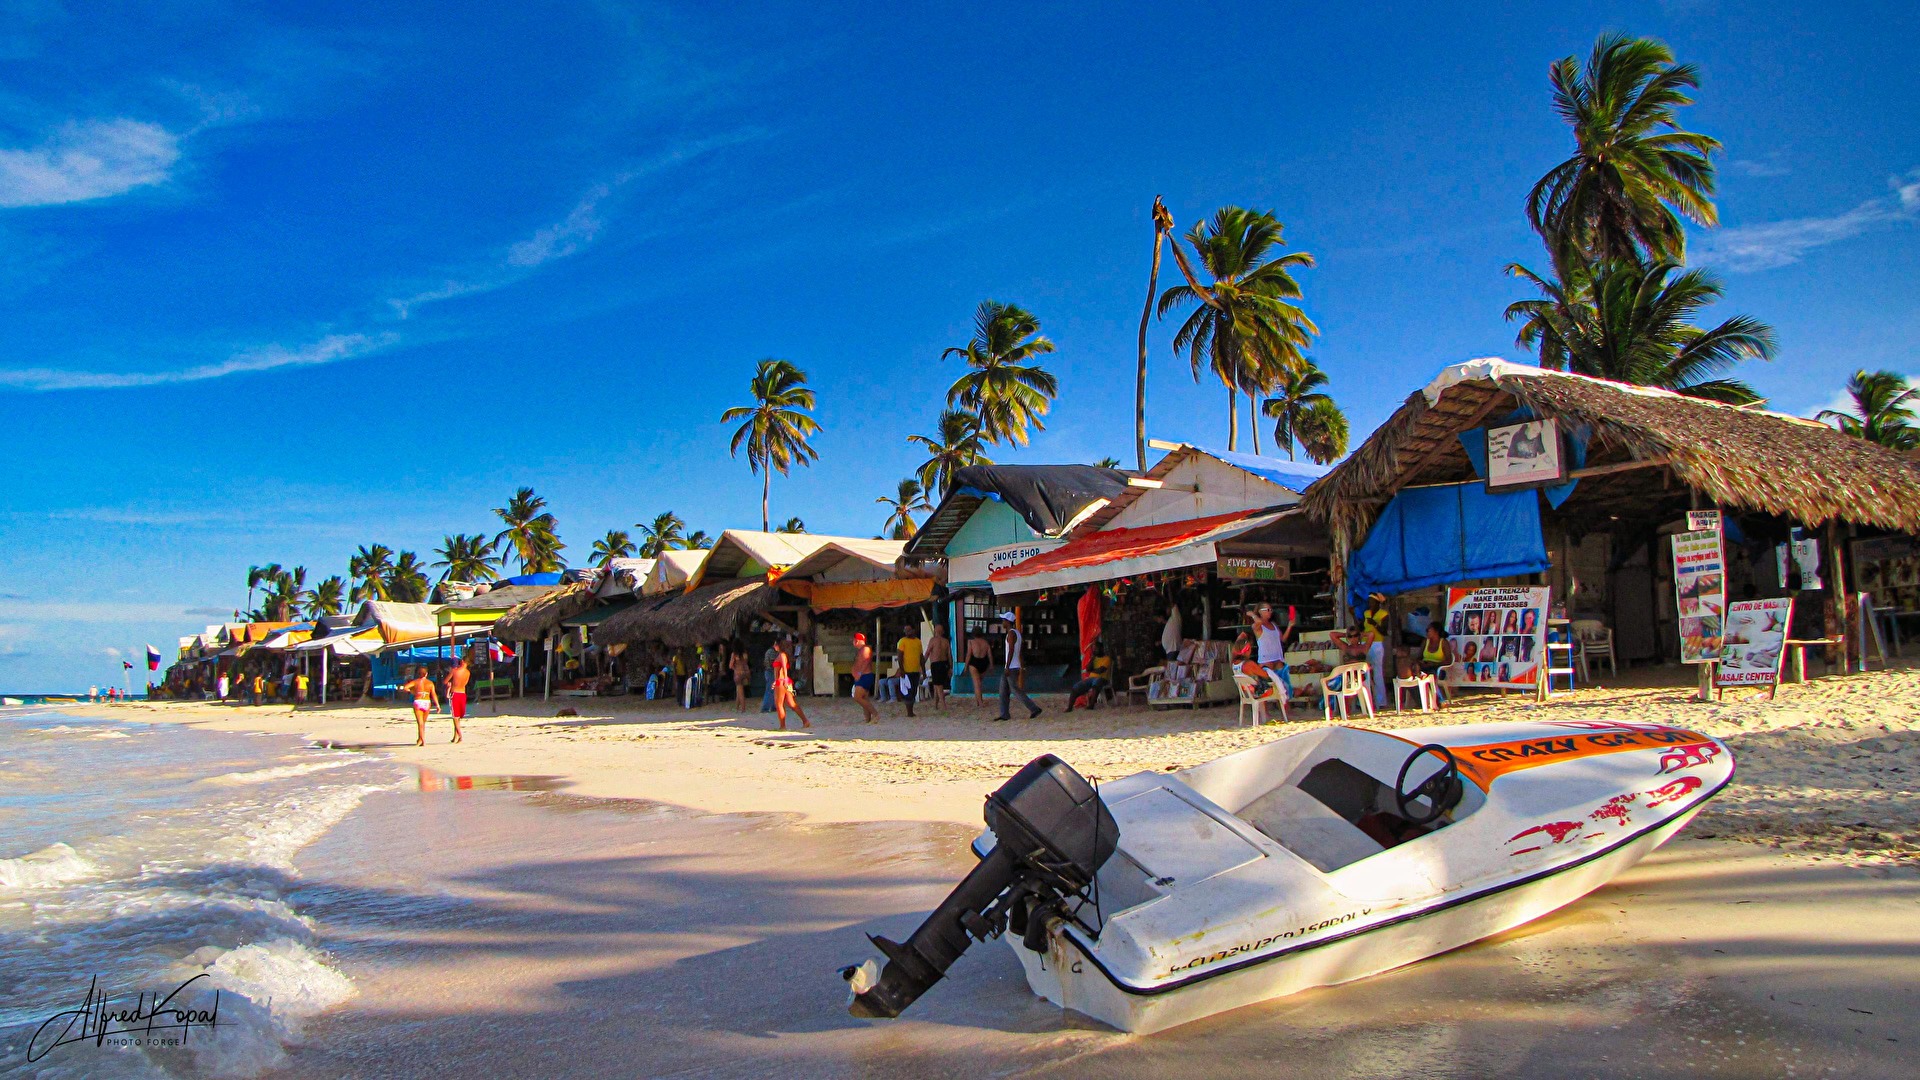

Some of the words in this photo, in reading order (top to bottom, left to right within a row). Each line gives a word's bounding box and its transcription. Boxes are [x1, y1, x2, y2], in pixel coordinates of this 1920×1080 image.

[993, 550, 1017, 561] SMOKE
[1020, 547, 1040, 558] SHOP
[1227, 558, 1247, 567] ELVIS
[1498, 587, 1530, 595] TRENZAS
[1493, 594, 1519, 602] BRAIDS
[1498, 601, 1529, 609] TRESSES
[1731, 602, 1752, 611] ENTRO
[1753, 602, 1762, 610] DE
[1745, 672, 1776, 681] CENTER
[1471, 737, 1579, 763] CRAZY
